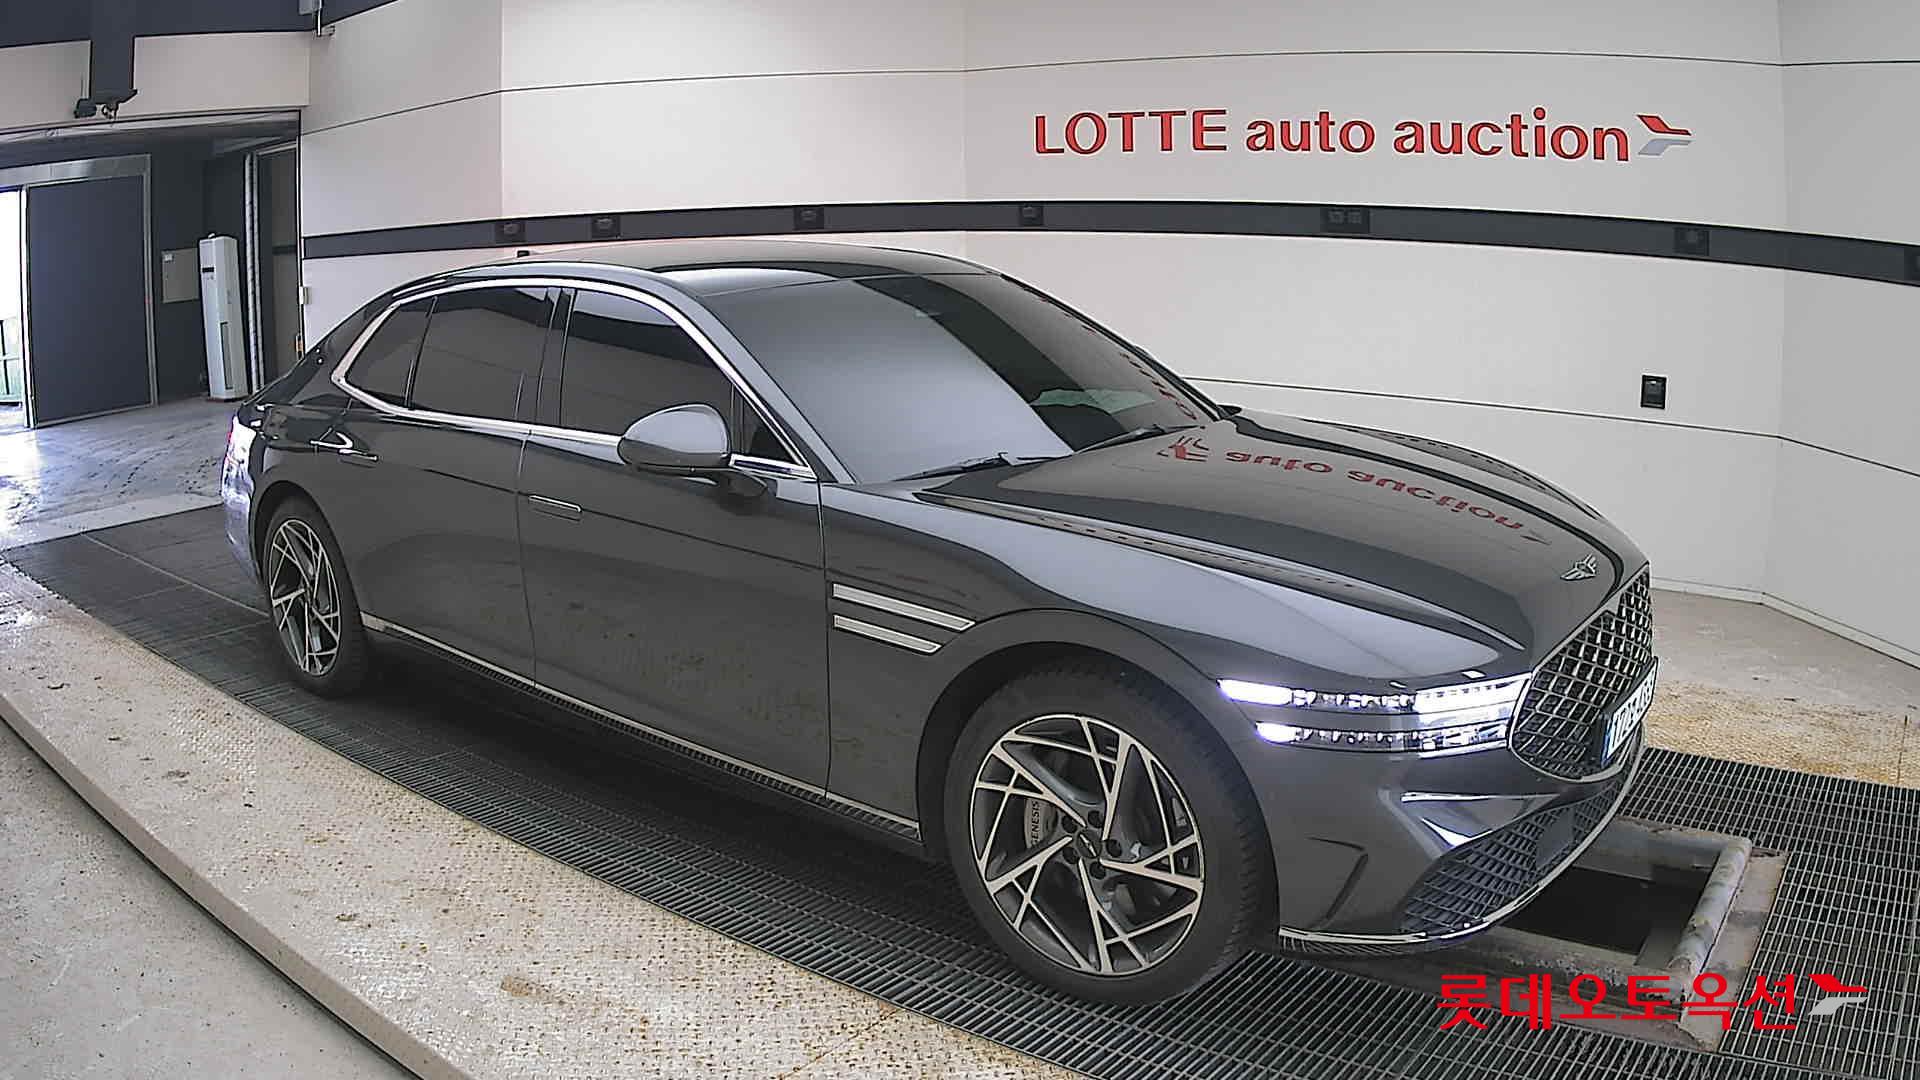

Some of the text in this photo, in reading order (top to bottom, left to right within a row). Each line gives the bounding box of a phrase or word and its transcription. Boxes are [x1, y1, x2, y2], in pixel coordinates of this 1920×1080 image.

[1034, 106, 1630, 162] LOTTE auto auction
